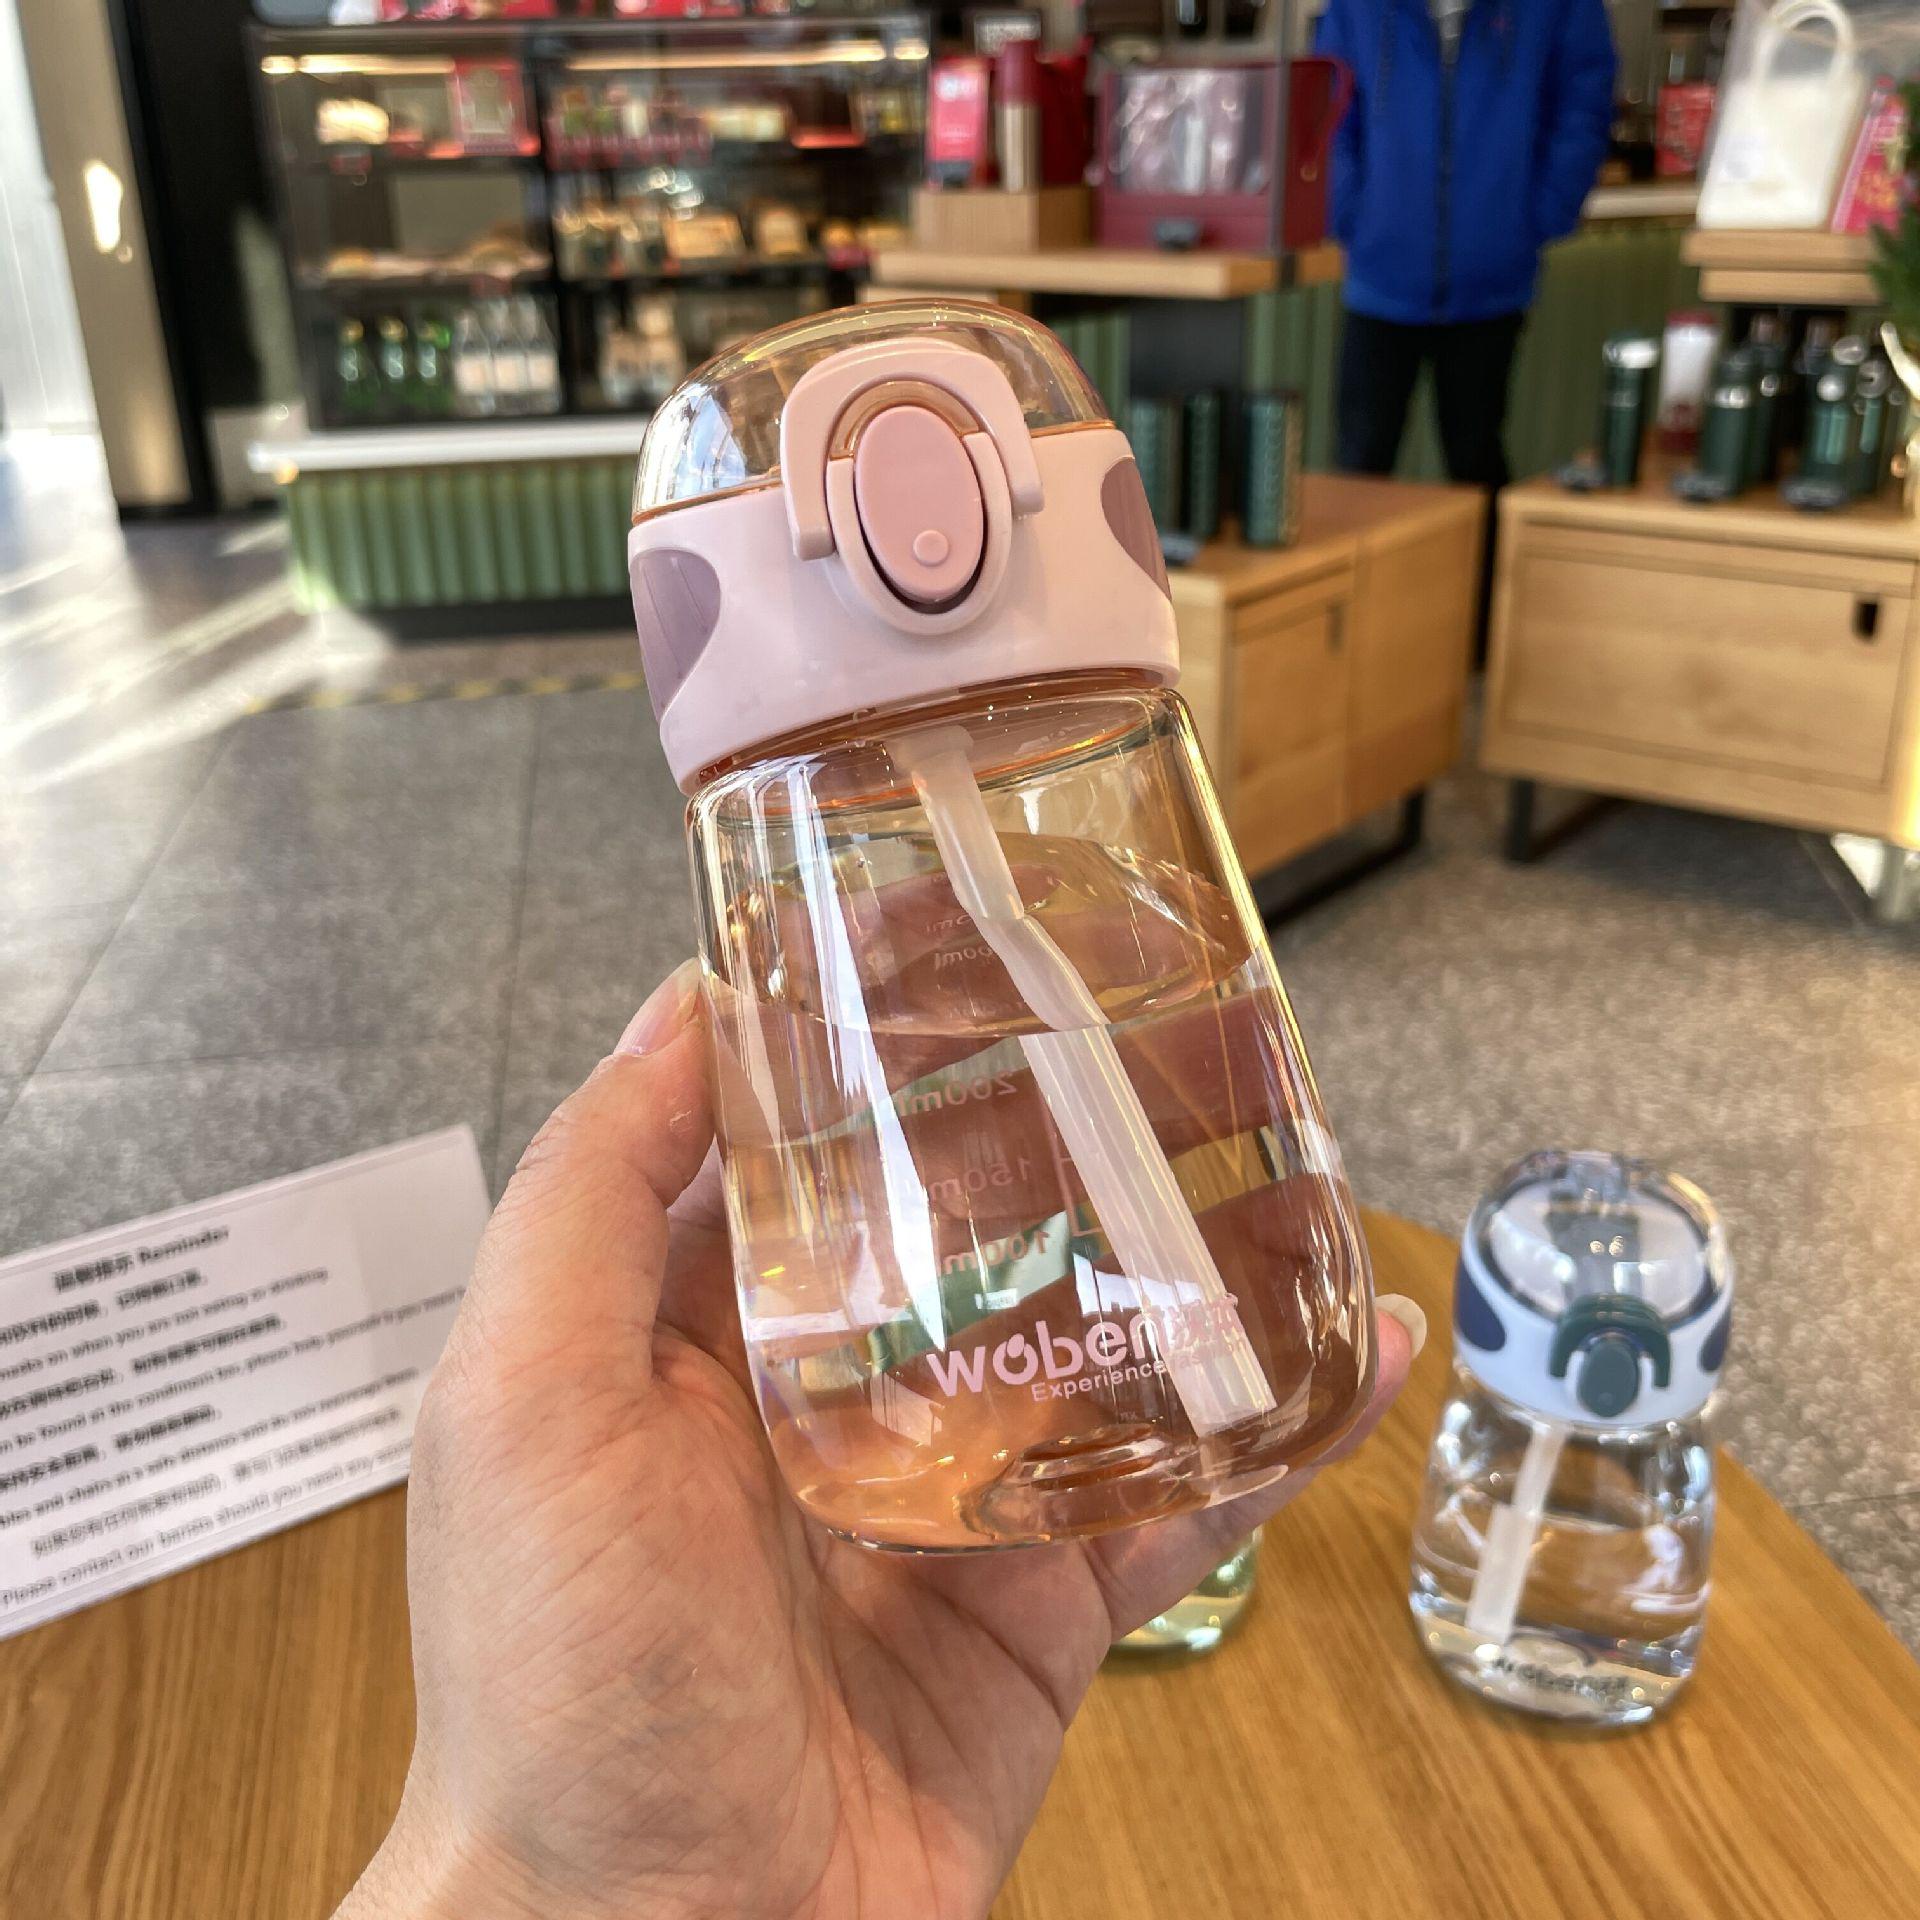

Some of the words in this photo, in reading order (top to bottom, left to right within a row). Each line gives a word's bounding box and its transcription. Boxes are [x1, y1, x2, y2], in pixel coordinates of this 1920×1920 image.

[137, 1225, 230, 1264] Reminder
[70, 1334, 114, 1359] when
[115, 1326, 146, 1349] you
[926, 1307, 1169, 1398] woben
[1031, 1358, 1168, 1403] Experience
[38, 1410, 88, 1442] found
[0, 1575, 57, 1610] Please
[58, 1547, 124, 1586] contact
[126, 1537, 155, 1560] our
[214, 1492, 270, 1525] should
[271, 1483, 302, 1511] you
[303, 1464, 345, 1491] need
